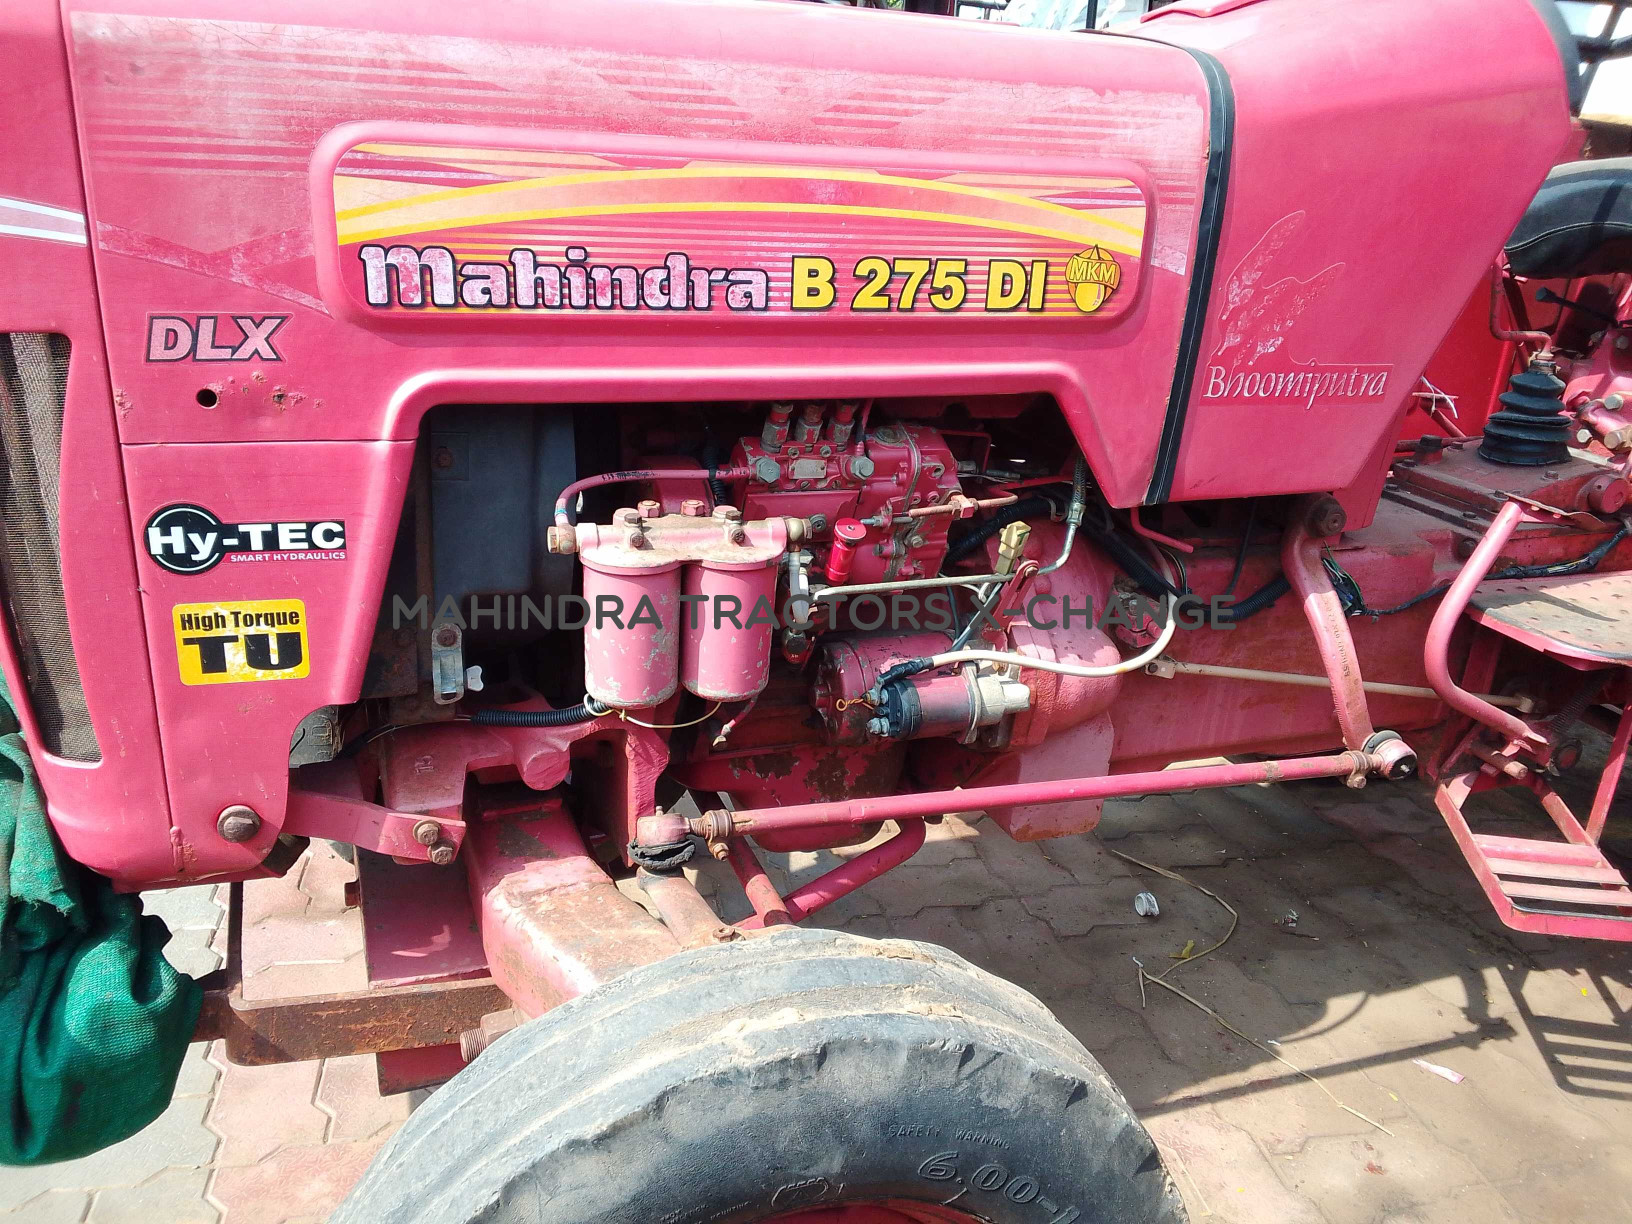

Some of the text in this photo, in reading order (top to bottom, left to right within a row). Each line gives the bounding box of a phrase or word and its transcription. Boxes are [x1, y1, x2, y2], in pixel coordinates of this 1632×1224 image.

[358, 245, 1049, 312] Mahindra B 275 DI
[1069, 258, 1118, 285] MKM
[146, 316, 288, 362] DLX
[1202, 364, 1388, 410] Bhoomiputra
[148, 522, 345, 561] Hy-TEC
[230, 552, 346, 562] SMART HYDRAULICS
[179, 610, 301, 631] High Torque
[182, 632, 303, 674] TU
[888, 1124, 1011, 1150] SAFETY WARNING
